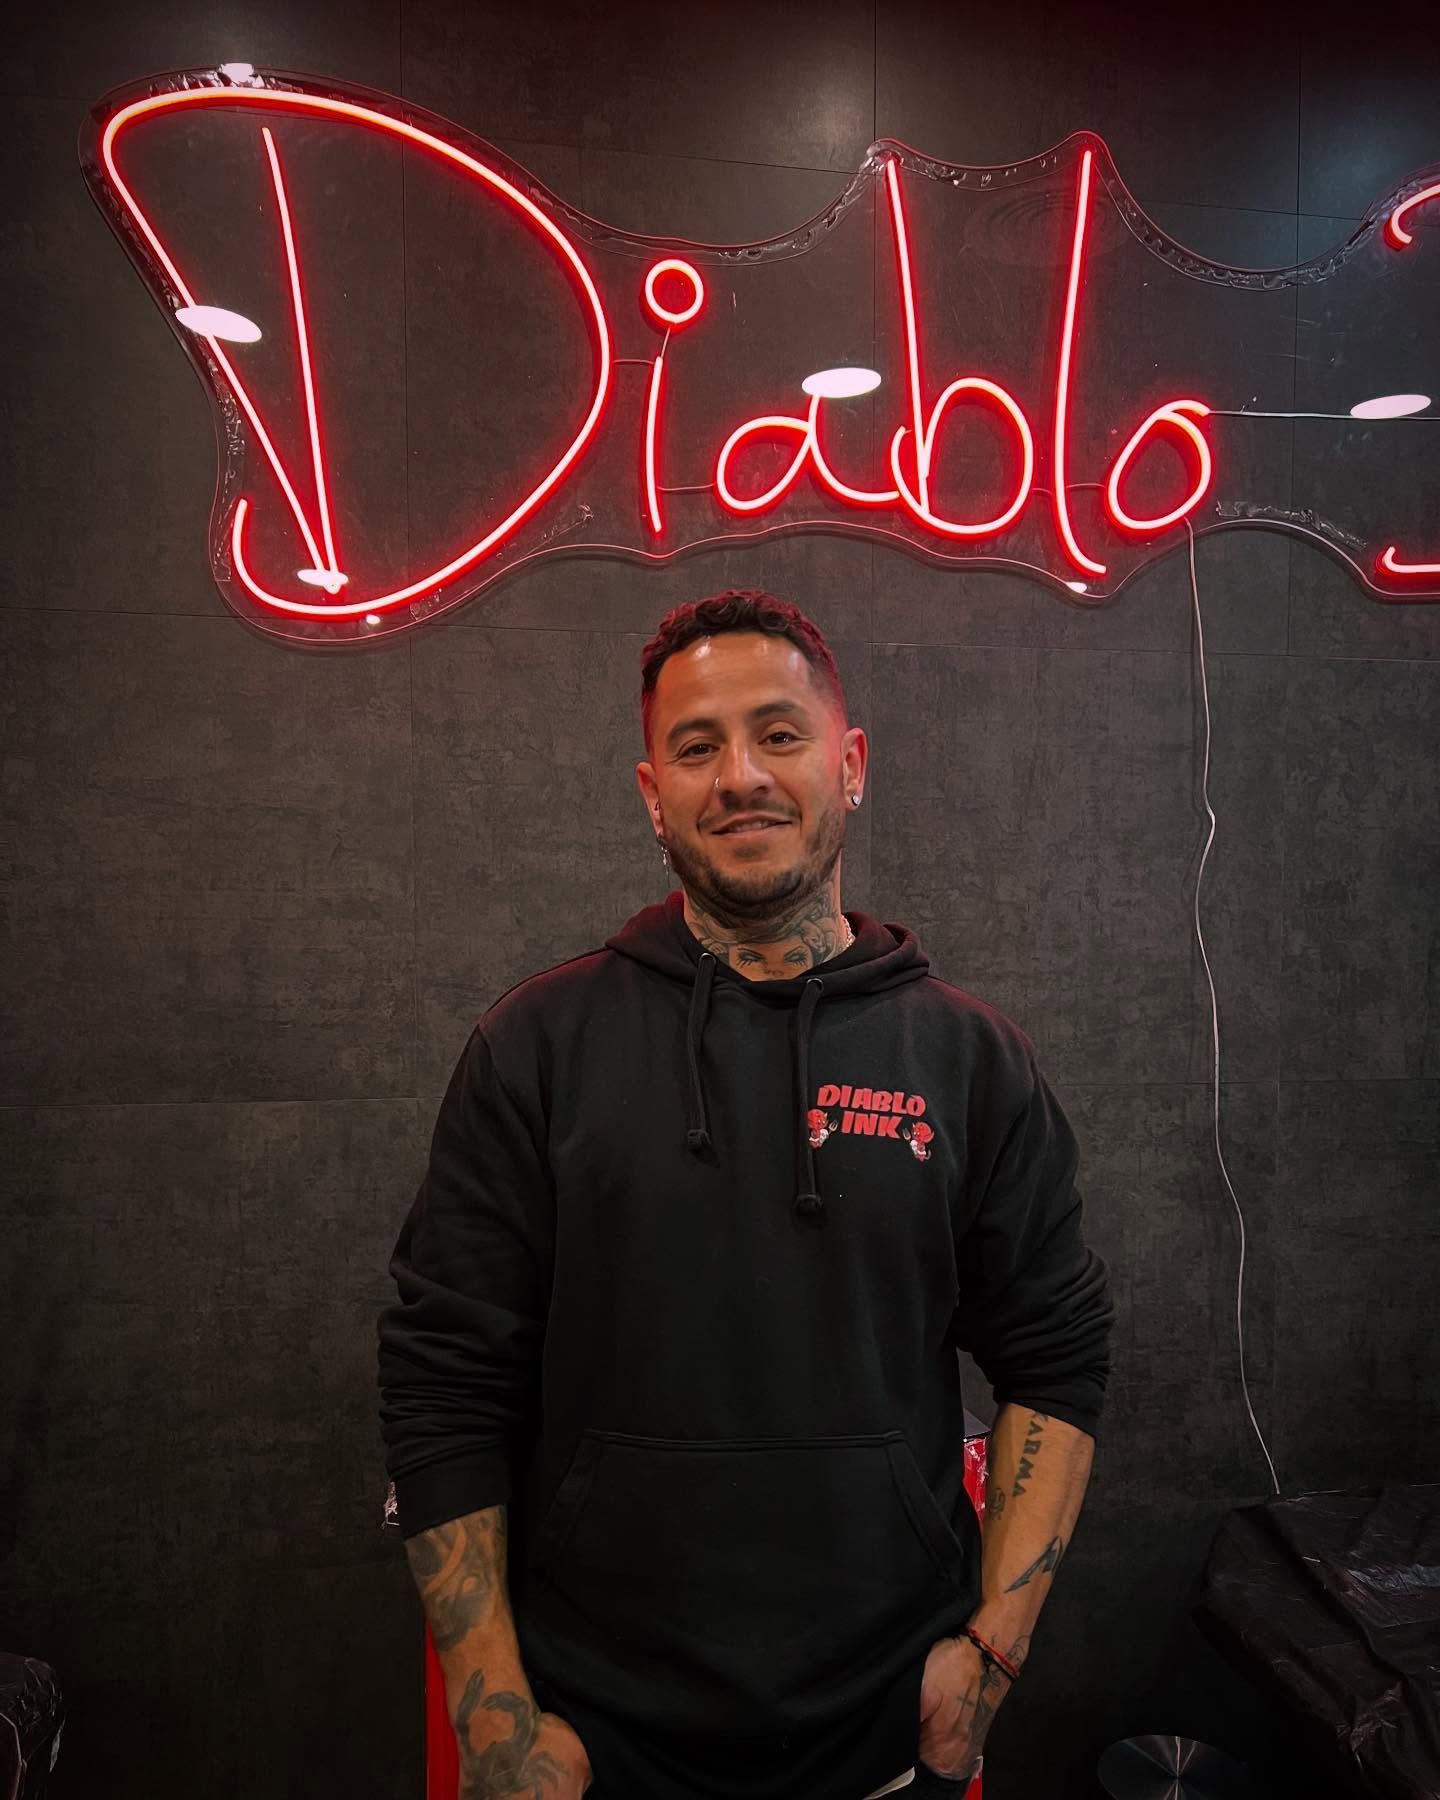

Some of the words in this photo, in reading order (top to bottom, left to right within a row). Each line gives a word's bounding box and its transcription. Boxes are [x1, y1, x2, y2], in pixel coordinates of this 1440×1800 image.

[101, 86, 1212, 616] Diablo
[817, 1084, 926, 1117] DIABLO
[841, 1110, 902, 1139] INK
